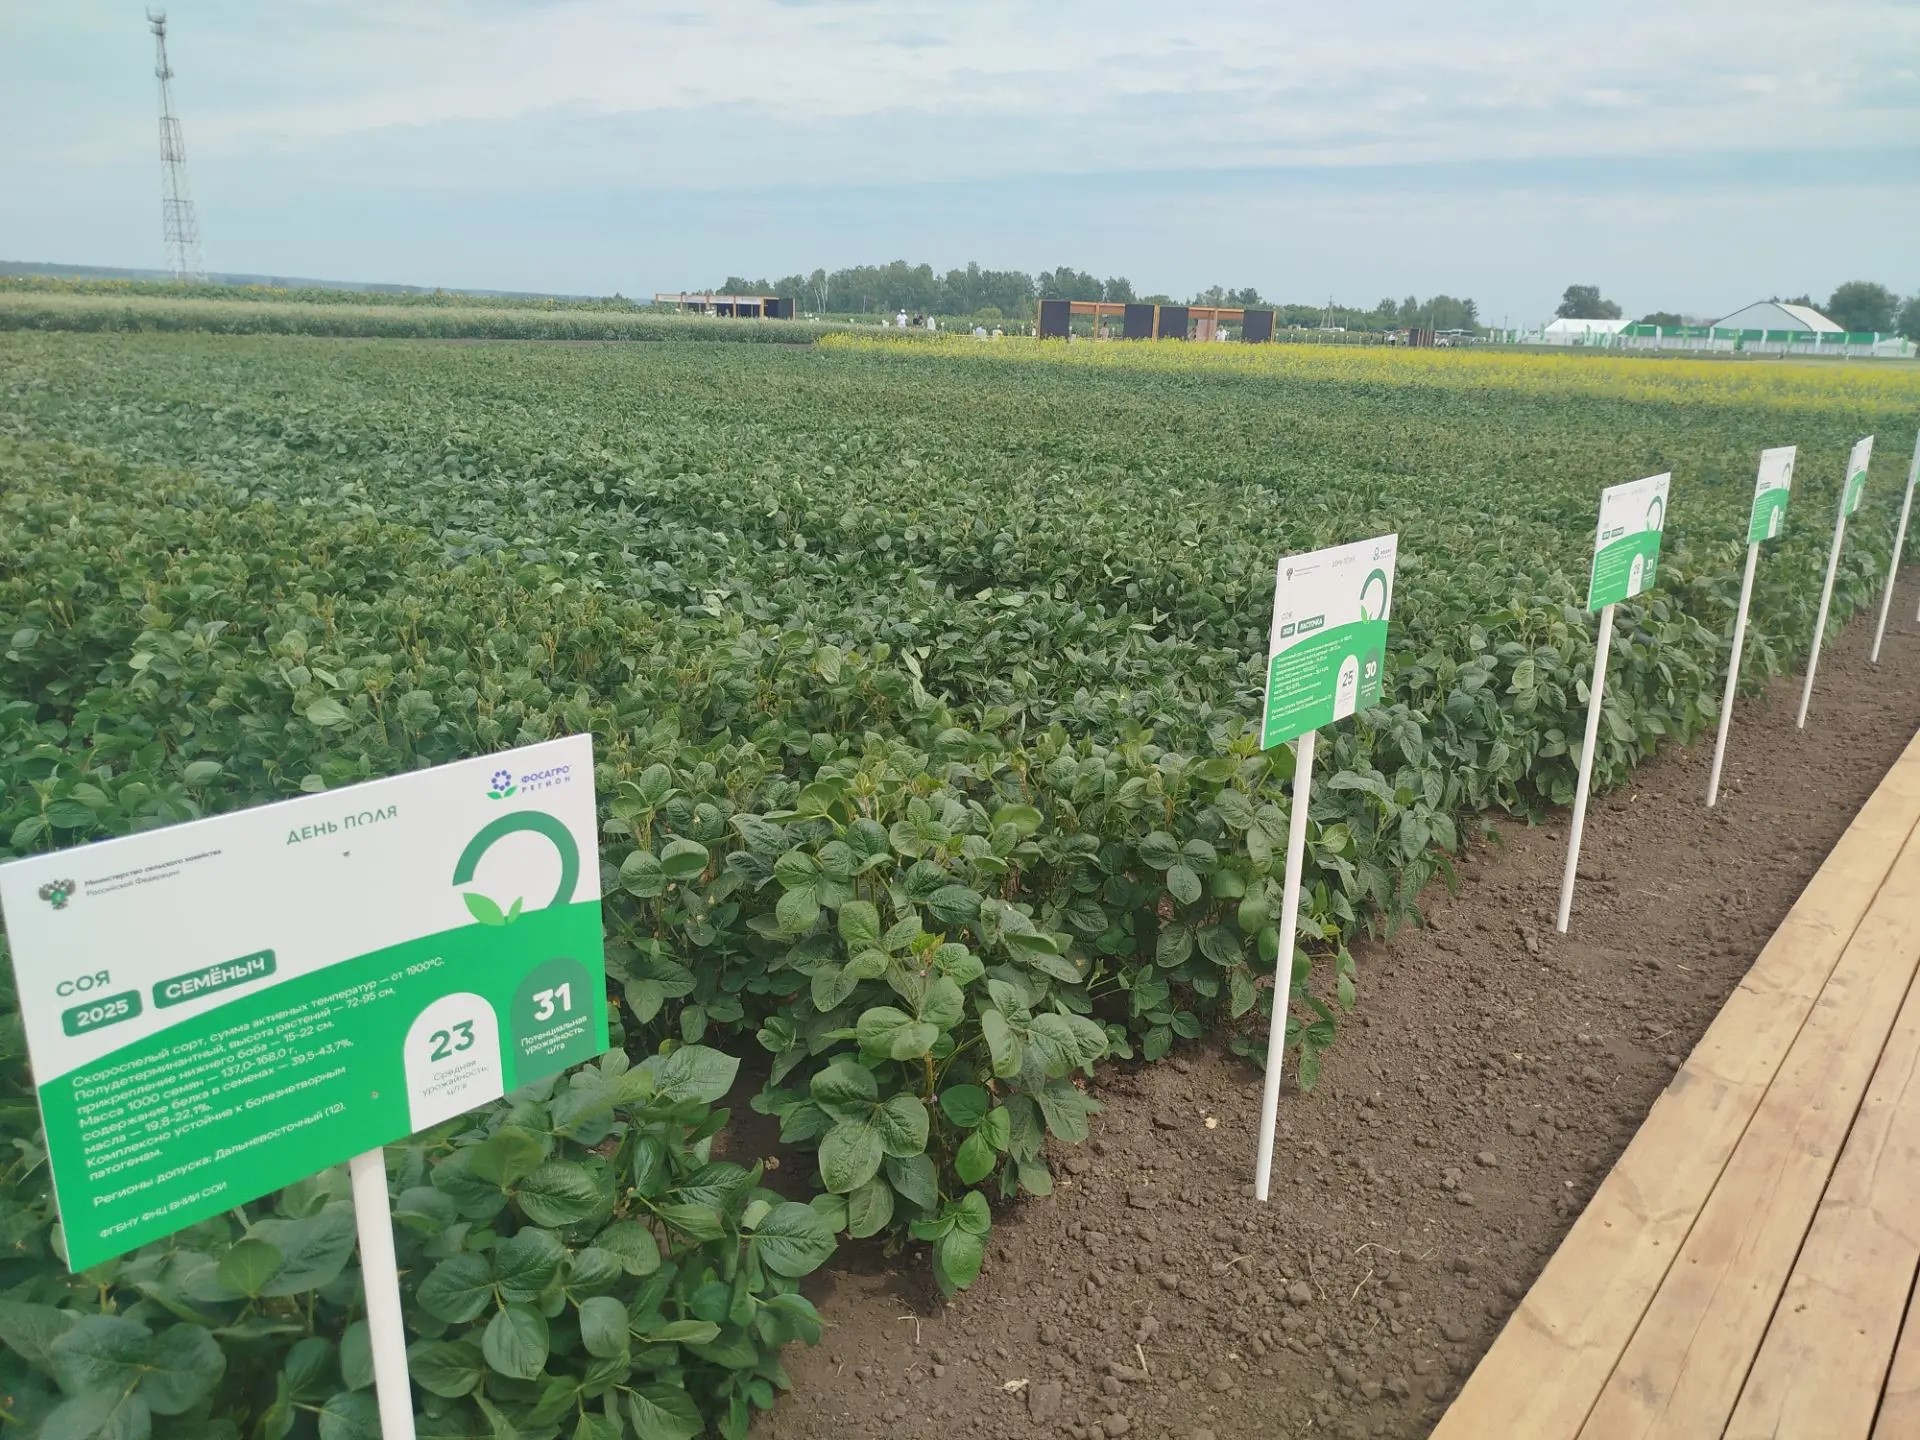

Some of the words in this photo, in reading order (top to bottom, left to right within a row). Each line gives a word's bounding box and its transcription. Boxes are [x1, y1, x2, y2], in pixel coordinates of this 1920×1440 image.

[1342, 670, 1353, 687] 25
[1364, 661, 1377, 679] 30
[521, 765, 570, 783] ФОСАГРО
[521, 776, 570, 793] РЕГИОН
[286, 821, 338, 845] ДЕНЬ
[344, 805, 397, 829] ПОЛЯ
[84, 869, 143, 887] Министерство
[144, 859, 184, 873] сельского
[185, 850, 222, 862] хозяйства
[86, 880, 134, 896] Российской
[134, 870, 180, 885] Федерации
[56, 969, 110, 997] СОЯ
[77, 999, 129, 1027] 2025
[165, 958, 265, 998] СЕМЁНЫЧ
[533, 982, 571, 1021] 31
[72, 1048, 170, 1087] Скороспелый
[172, 1038, 207, 1054] сорт,
[210, 1023, 250, 1042] сумма
[252, 1004, 308, 1028] активных
[311, 980, 377, 1008] температур
[390, 971, 403, 981] от
[228, 1028, 274, 1049] высота
[275, 1007, 331, 1035] растений
[346, 991, 377, 1008] 72-95
[521, 1015, 587, 1046] Потенциальная
[429, 1019, 475, 1063] 23
[547, 1042, 565, 1055] ц/га
[77, 1075, 176, 1114] прикрепление
[179, 1055, 235, 1079] нижнего
[236, 1043, 268, 1059] боба
[283, 1025, 314, 1042] 15-22
[433, 1060, 477, 1081] Средняя
[79, 1108, 124, 1128] Масса
[127, 1093, 160, 1110] 1000
[163, 1080, 204, 1098] семян
[82, 1105, 169, 1141] содержание
[171, 1091, 210, 1109] белка
[211, 1087, 220, 1095] в
[223, 1068, 274, 1091] семенах
[86, 1132, 171, 1168] Комплексно
[174, 1108, 233, 1137] устойчив
[235, 1105, 242, 1113] к
[245, 1066, 346, 1109] болезнетворным
[84, 1134, 127, 1155] масла
[93, 1179, 154, 1207] Регионы
[157, 1156, 212, 1184] допуска:
[214, 1111, 323, 1161] Дальневосточный
[99, 1217, 138, 1238] ФГБНУ
[141, 1206, 168, 1221] ФНЦ
[169, 1192, 200, 1210] ВНИИ
[201, 1182, 227, 1197] СОИ
